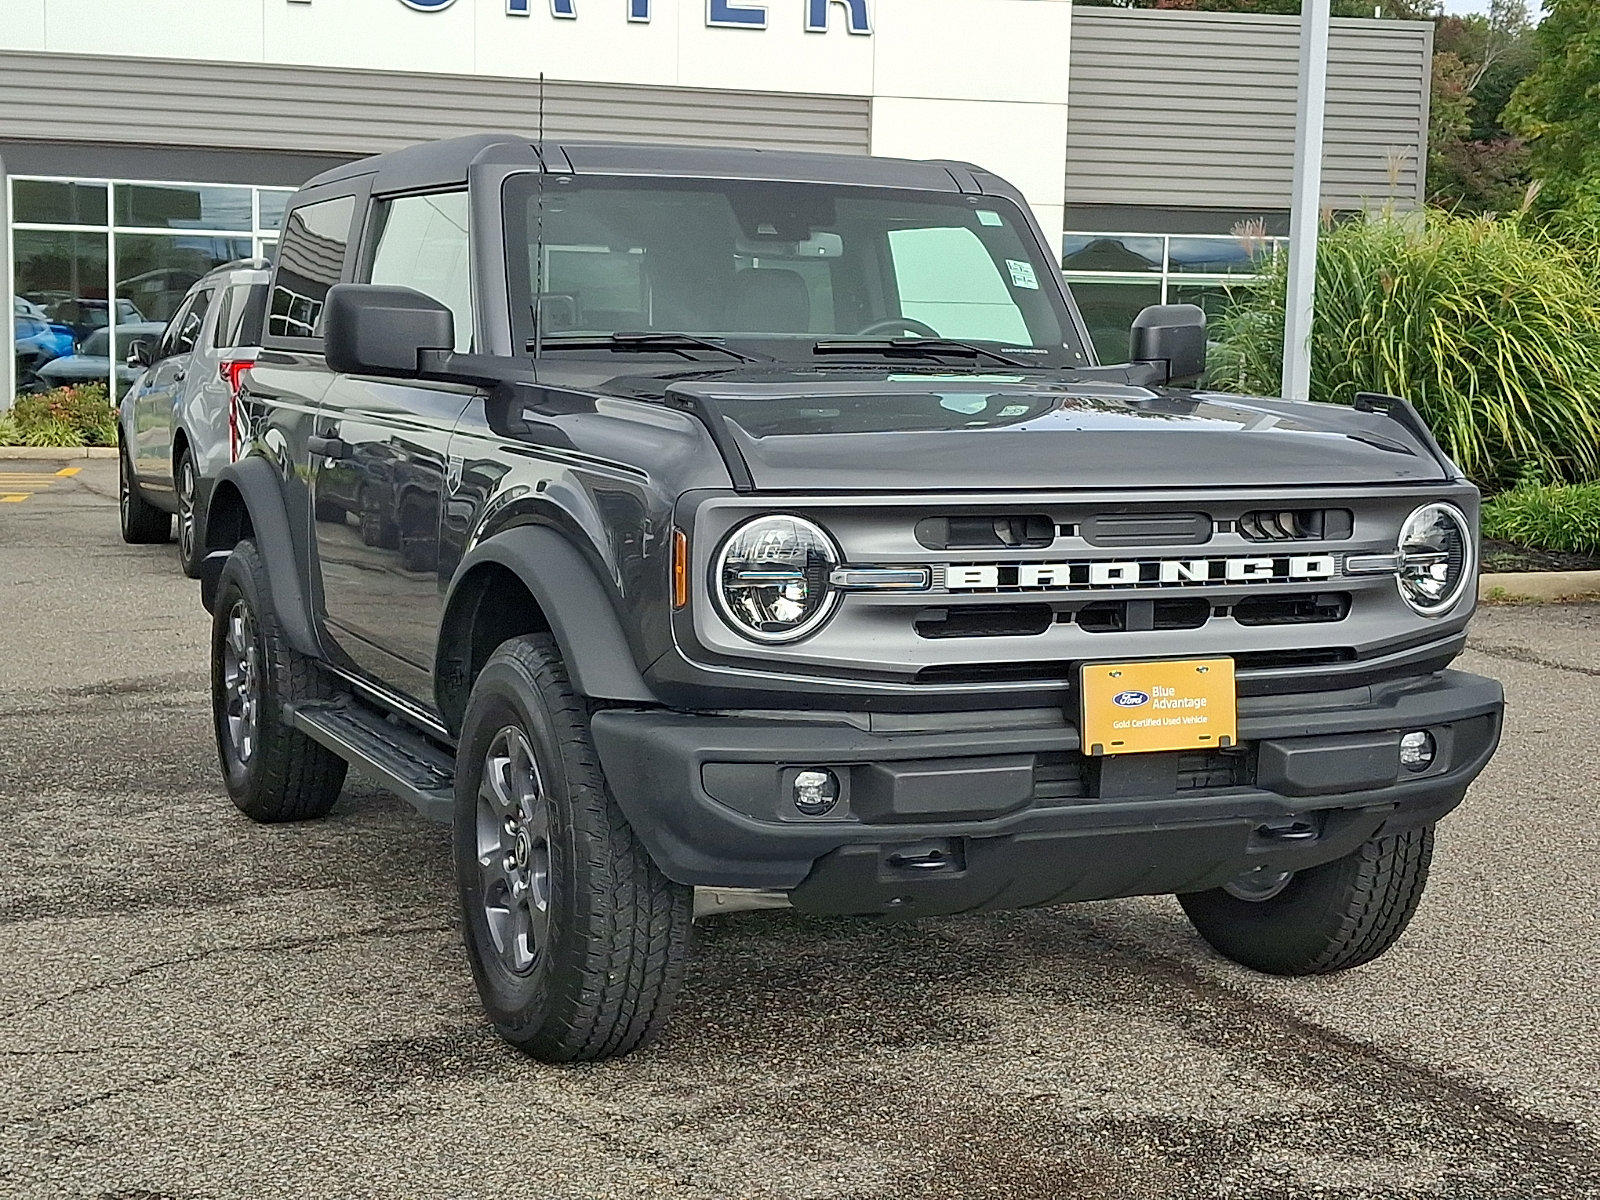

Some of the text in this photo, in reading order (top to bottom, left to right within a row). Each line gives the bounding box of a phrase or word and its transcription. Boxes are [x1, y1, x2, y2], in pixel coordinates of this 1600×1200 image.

[945, 555, 1335, 589] BRONCO
[1152, 686, 1175, 697] Blue
[1120, 693, 1142, 704] Ford
[1152, 697, 1207, 709] Advantage
[1113, 715, 1208, 729] Gold Certified Used Vehicle
